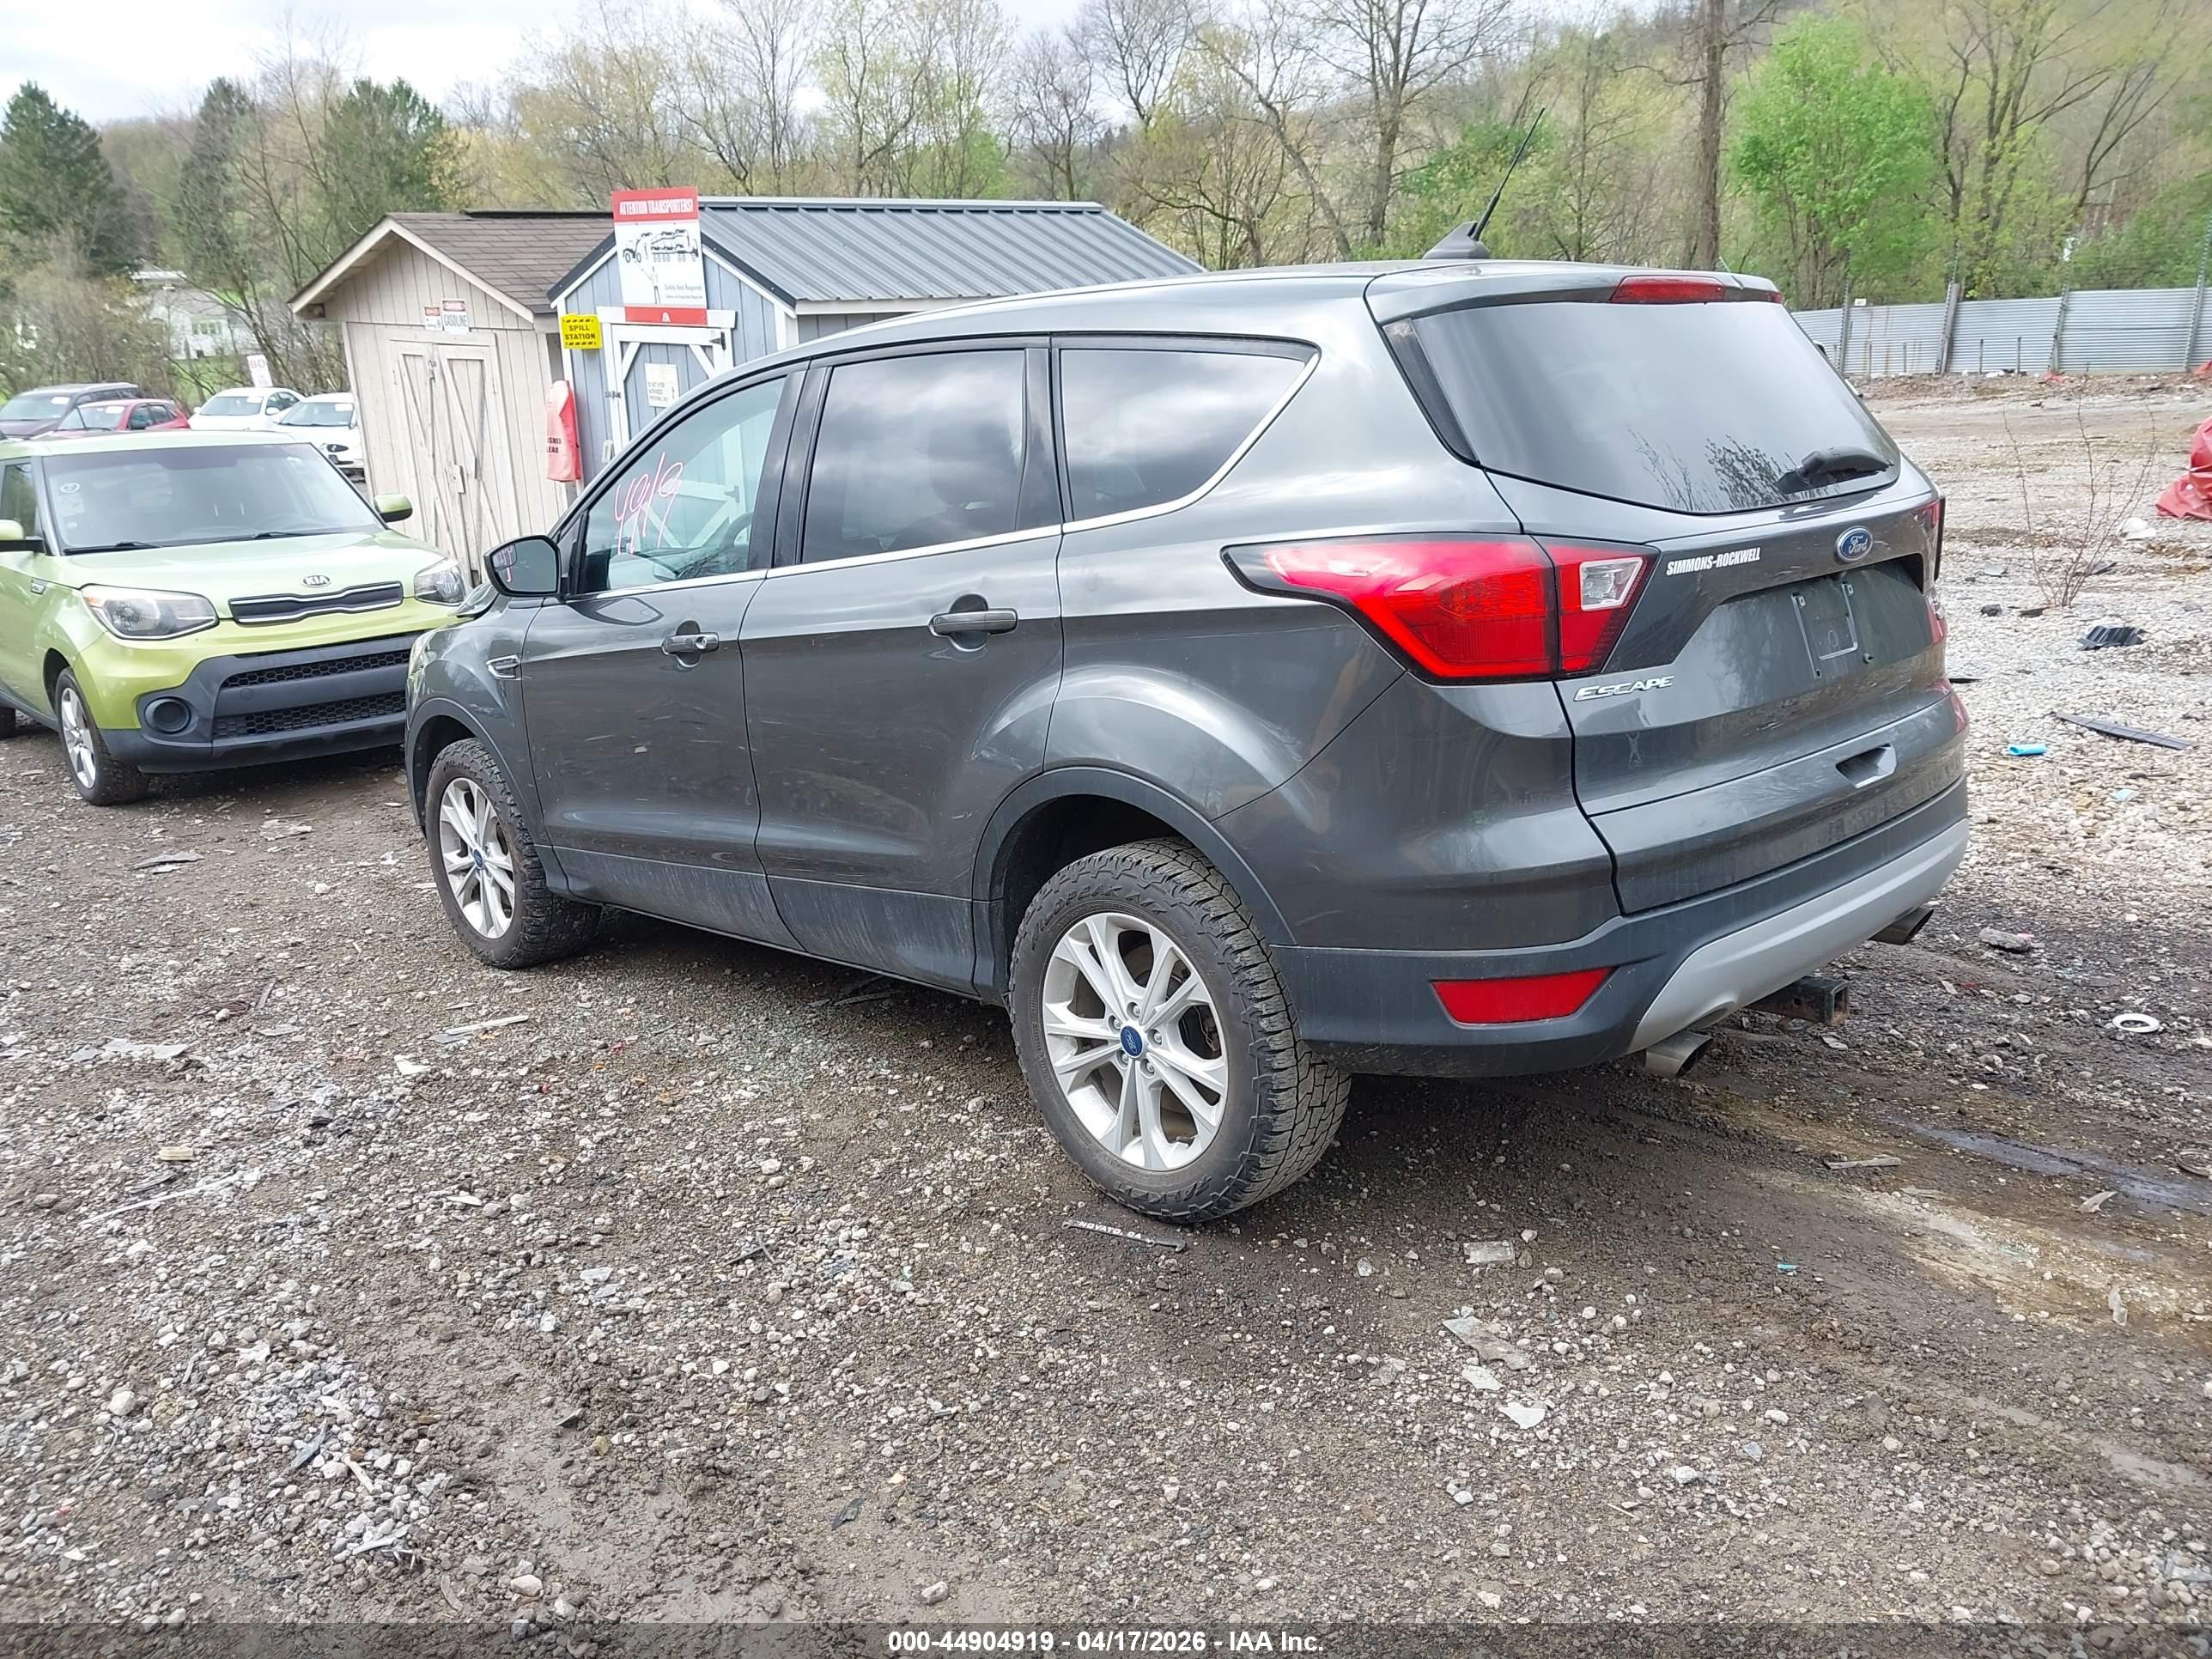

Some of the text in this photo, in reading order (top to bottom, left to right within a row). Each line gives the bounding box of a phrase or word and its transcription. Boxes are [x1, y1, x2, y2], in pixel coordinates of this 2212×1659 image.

[443, 314, 468, 327] GASOLINE
[1848, 534, 1869, 555] Ford
[1666, 546, 1761, 576] SIMMONS-ROCKWELL
[305, 575, 328, 586] KIA
[1572, 675, 1675, 702] ESCAPE
